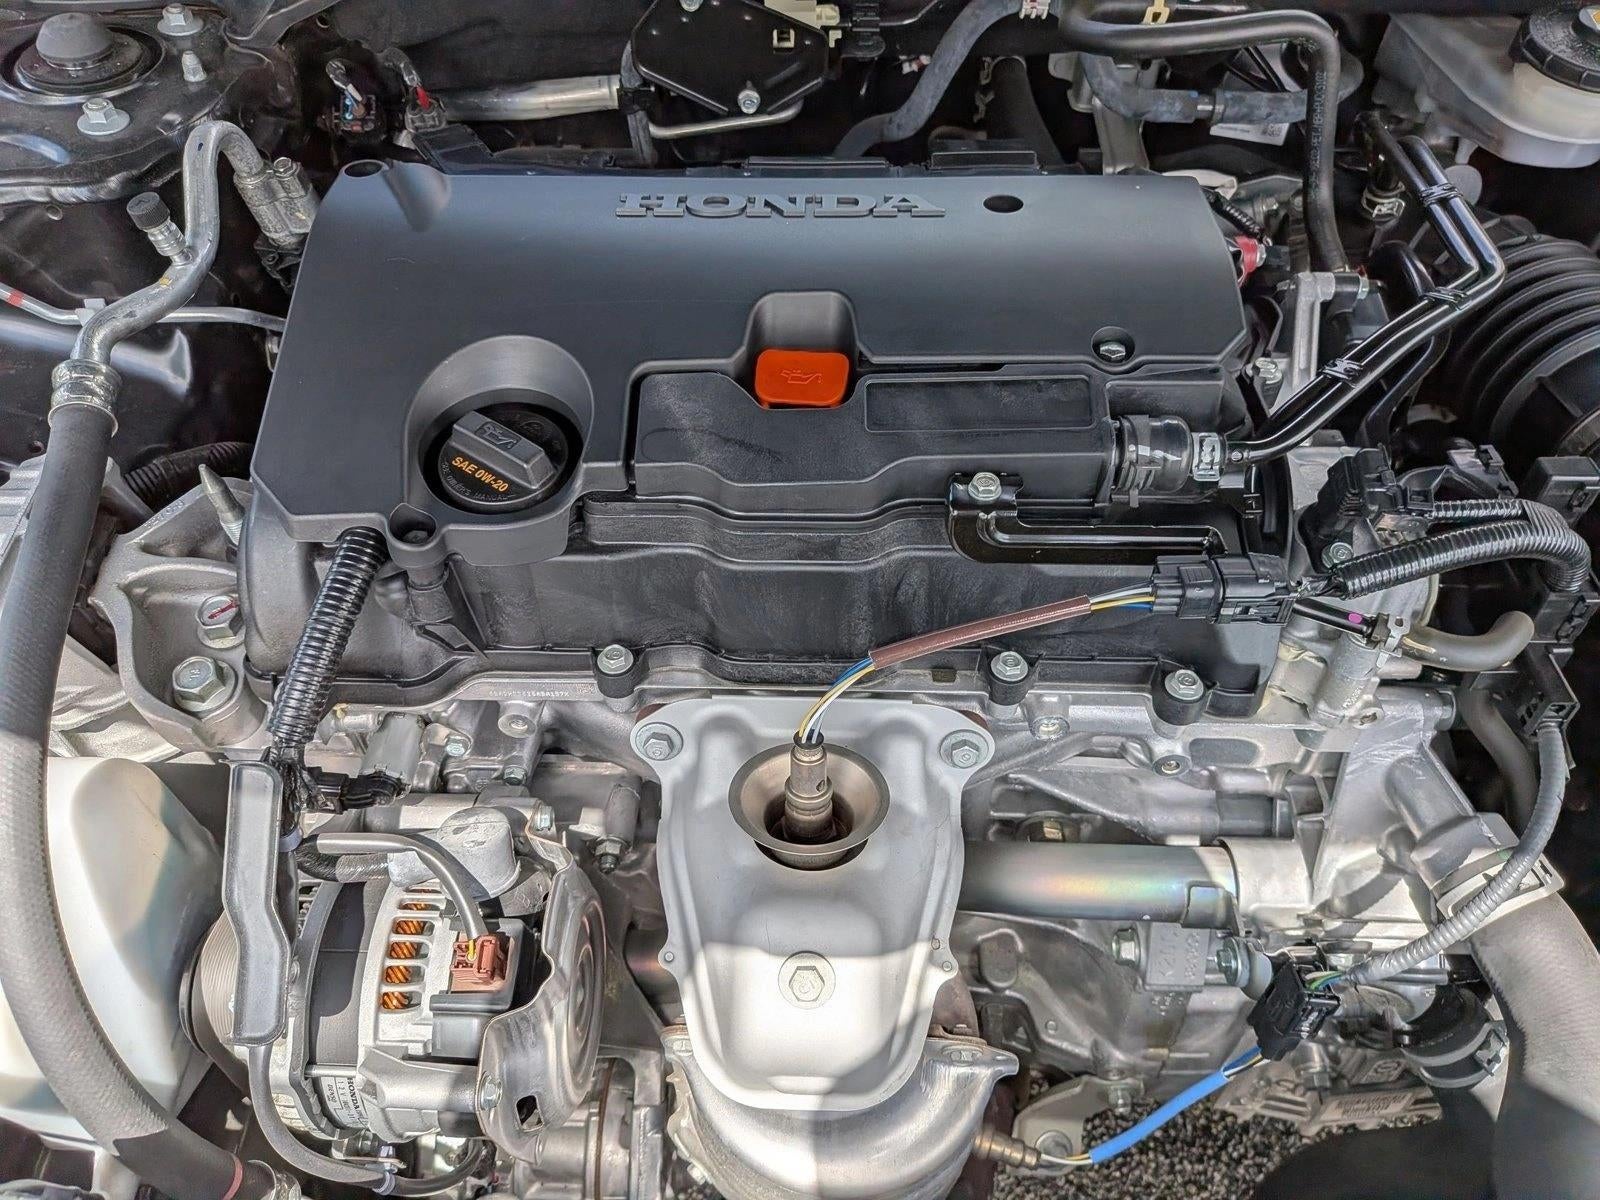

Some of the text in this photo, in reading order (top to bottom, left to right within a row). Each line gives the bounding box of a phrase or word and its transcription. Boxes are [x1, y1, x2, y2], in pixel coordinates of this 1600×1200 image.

[616, 193, 945, 218] HONDA
[451, 456, 509, 492] SAE 0W-20
[347, 1077, 360, 1110] HONDA
